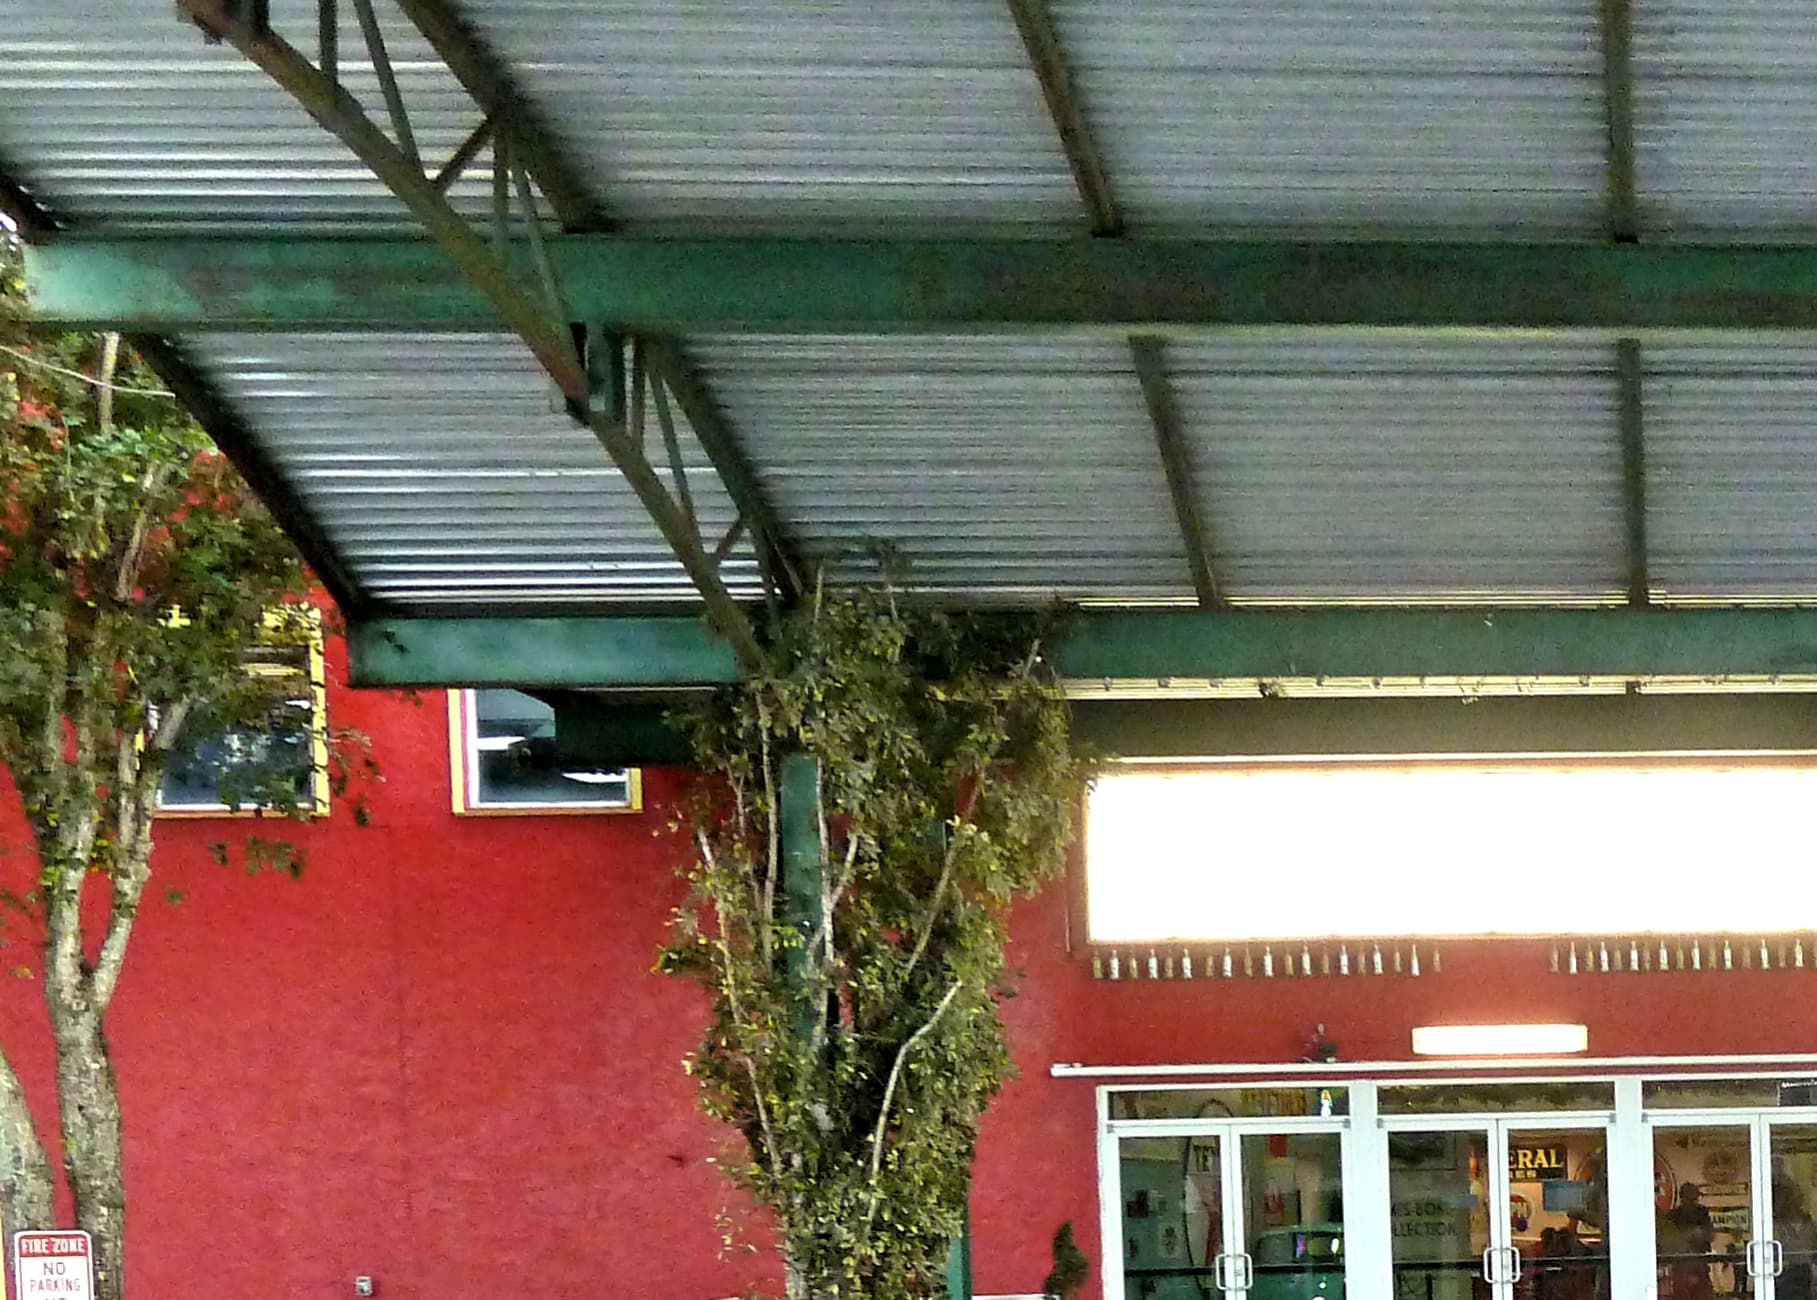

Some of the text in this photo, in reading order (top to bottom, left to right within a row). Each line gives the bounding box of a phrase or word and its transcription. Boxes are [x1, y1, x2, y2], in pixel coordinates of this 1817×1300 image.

[22, 1238, 85, 1253] FIRE ZONE
[43, 1262, 66, 1275] NO
[30, 1278, 81, 1292] PARKING
